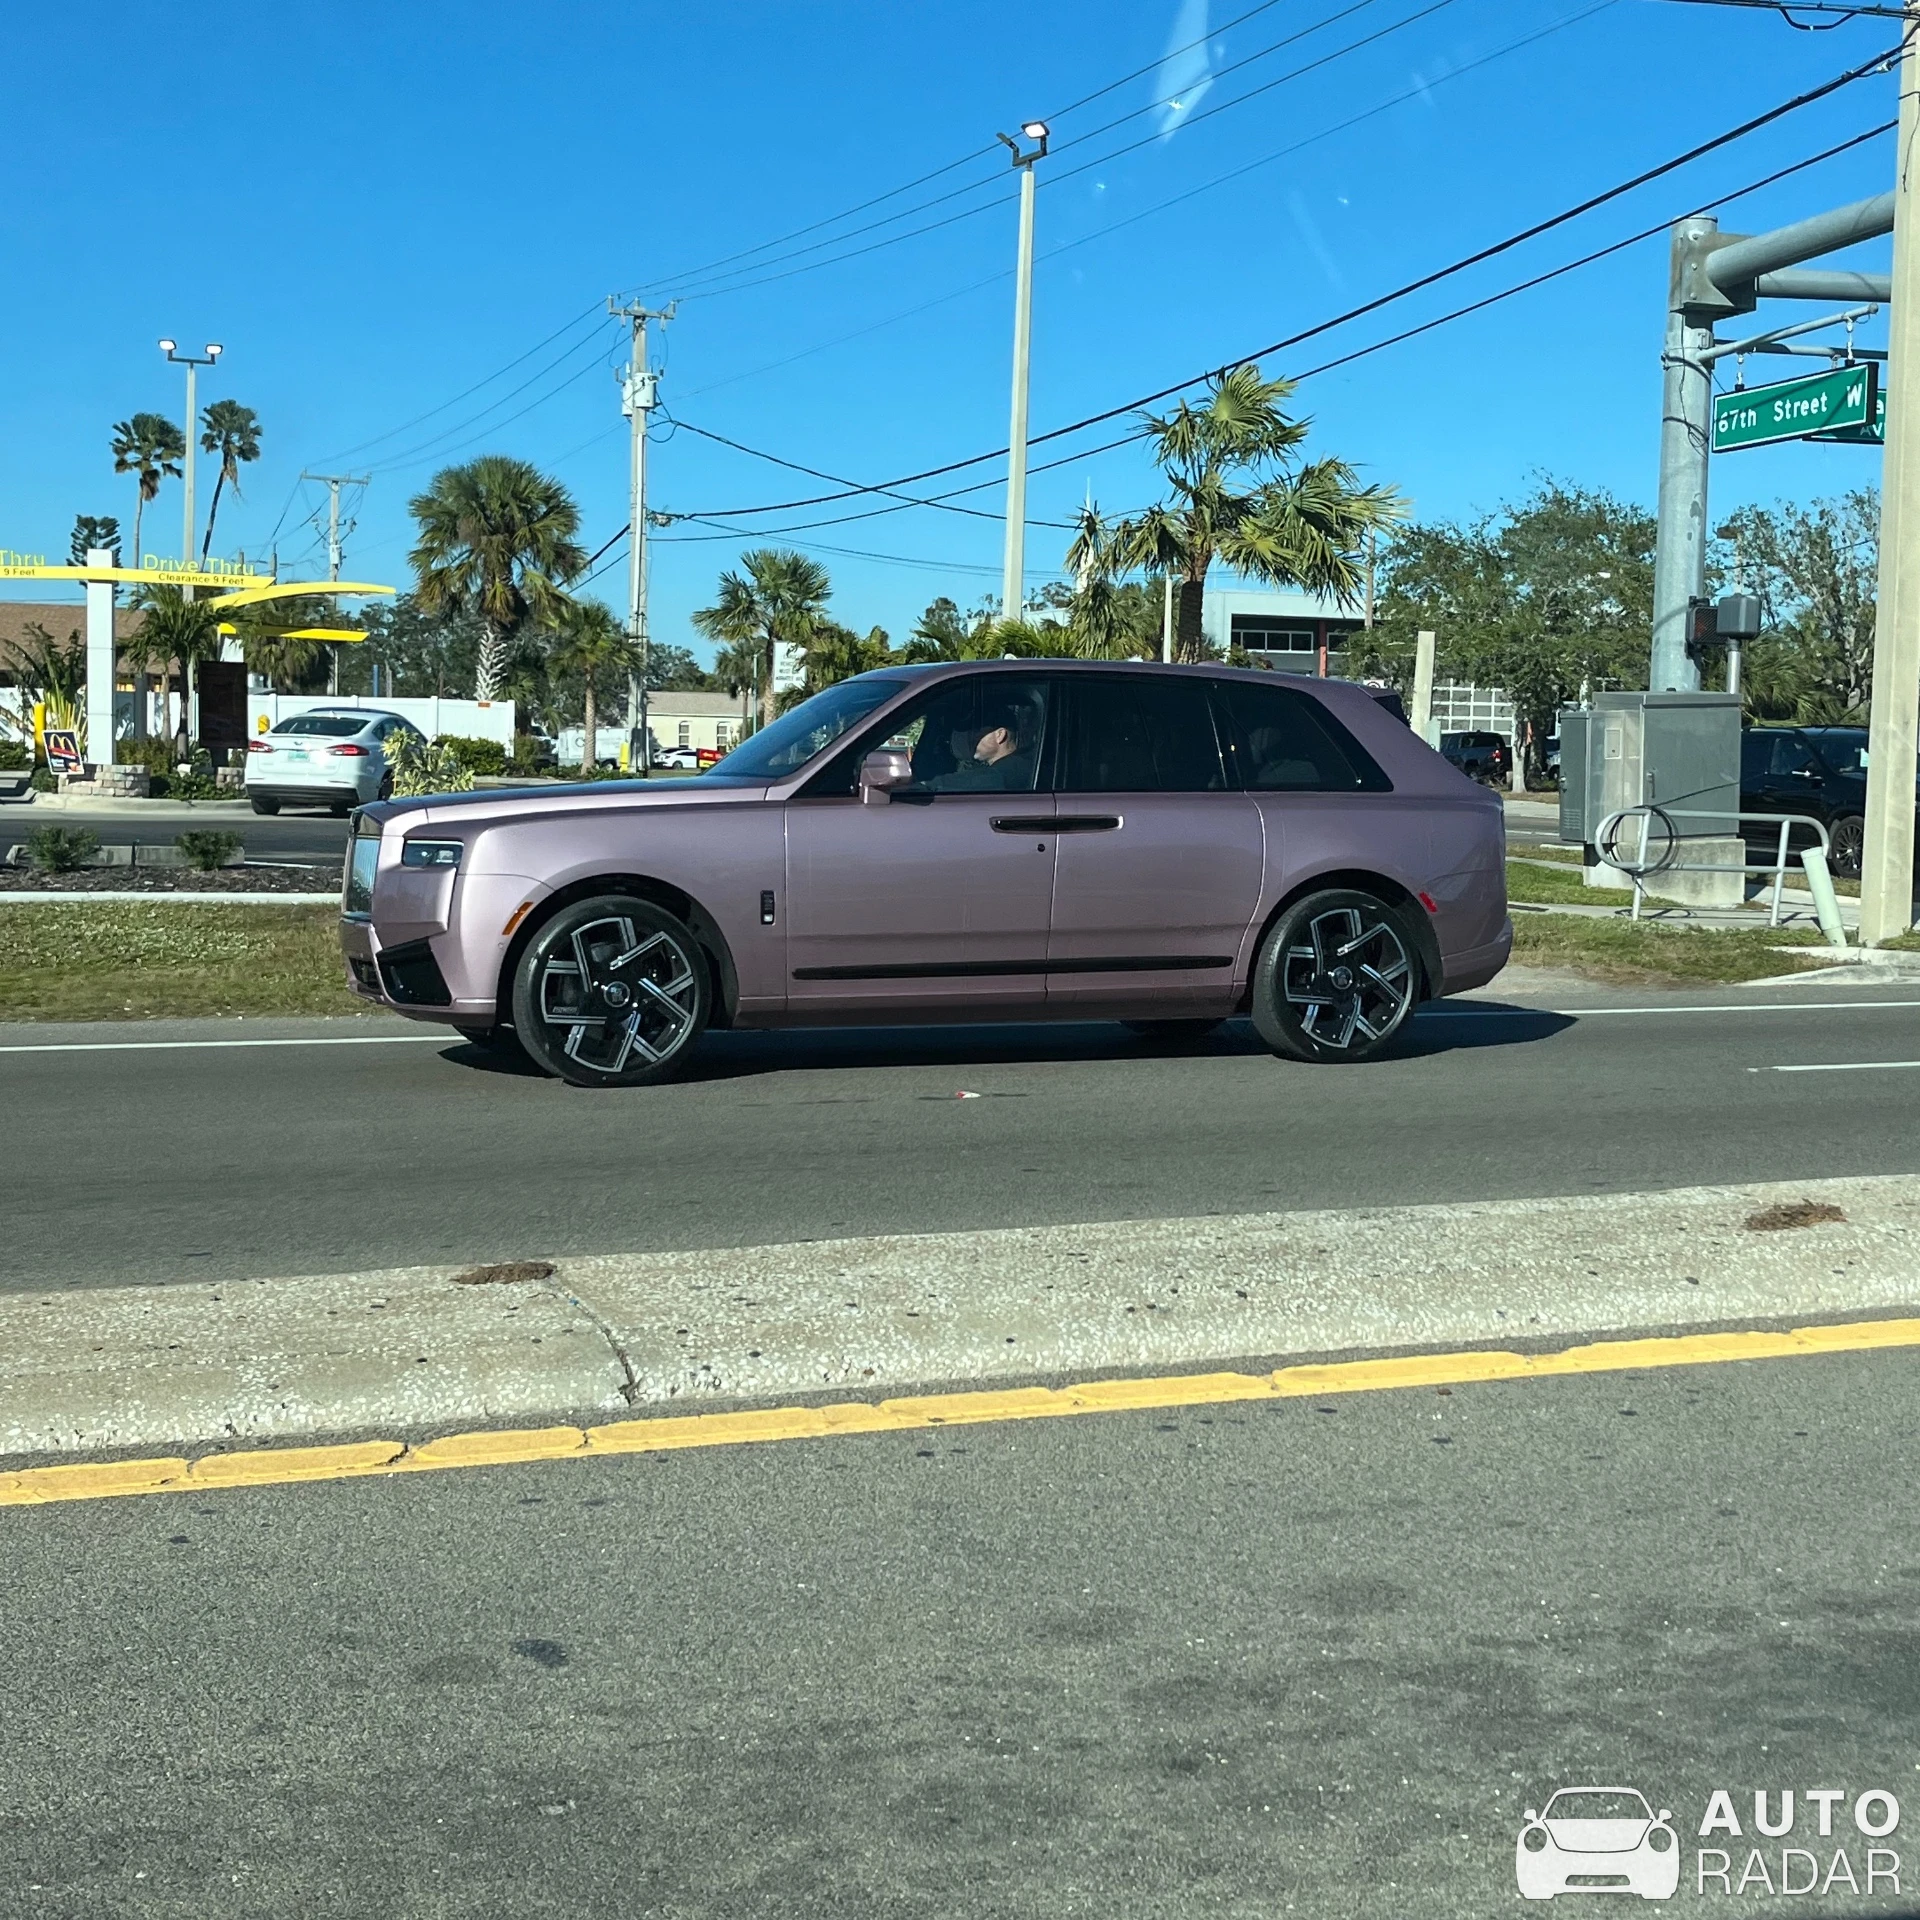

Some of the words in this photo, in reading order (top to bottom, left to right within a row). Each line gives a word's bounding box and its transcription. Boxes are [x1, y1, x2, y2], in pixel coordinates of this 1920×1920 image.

[1718, 409, 1757, 433] 67th
[1773, 391, 1828, 422] Street
[1847, 383, 1863, 408] W
[3, 567, 10, 576] 9
[13, 567, 35, 576] Feet
[143, 553, 199, 573] Drive
[206, 557, 255, 576] Thru
[158, 572, 210, 584] Clearance
[213, 575, 219, 584] 9
[222, 577, 244, 586] Feet
